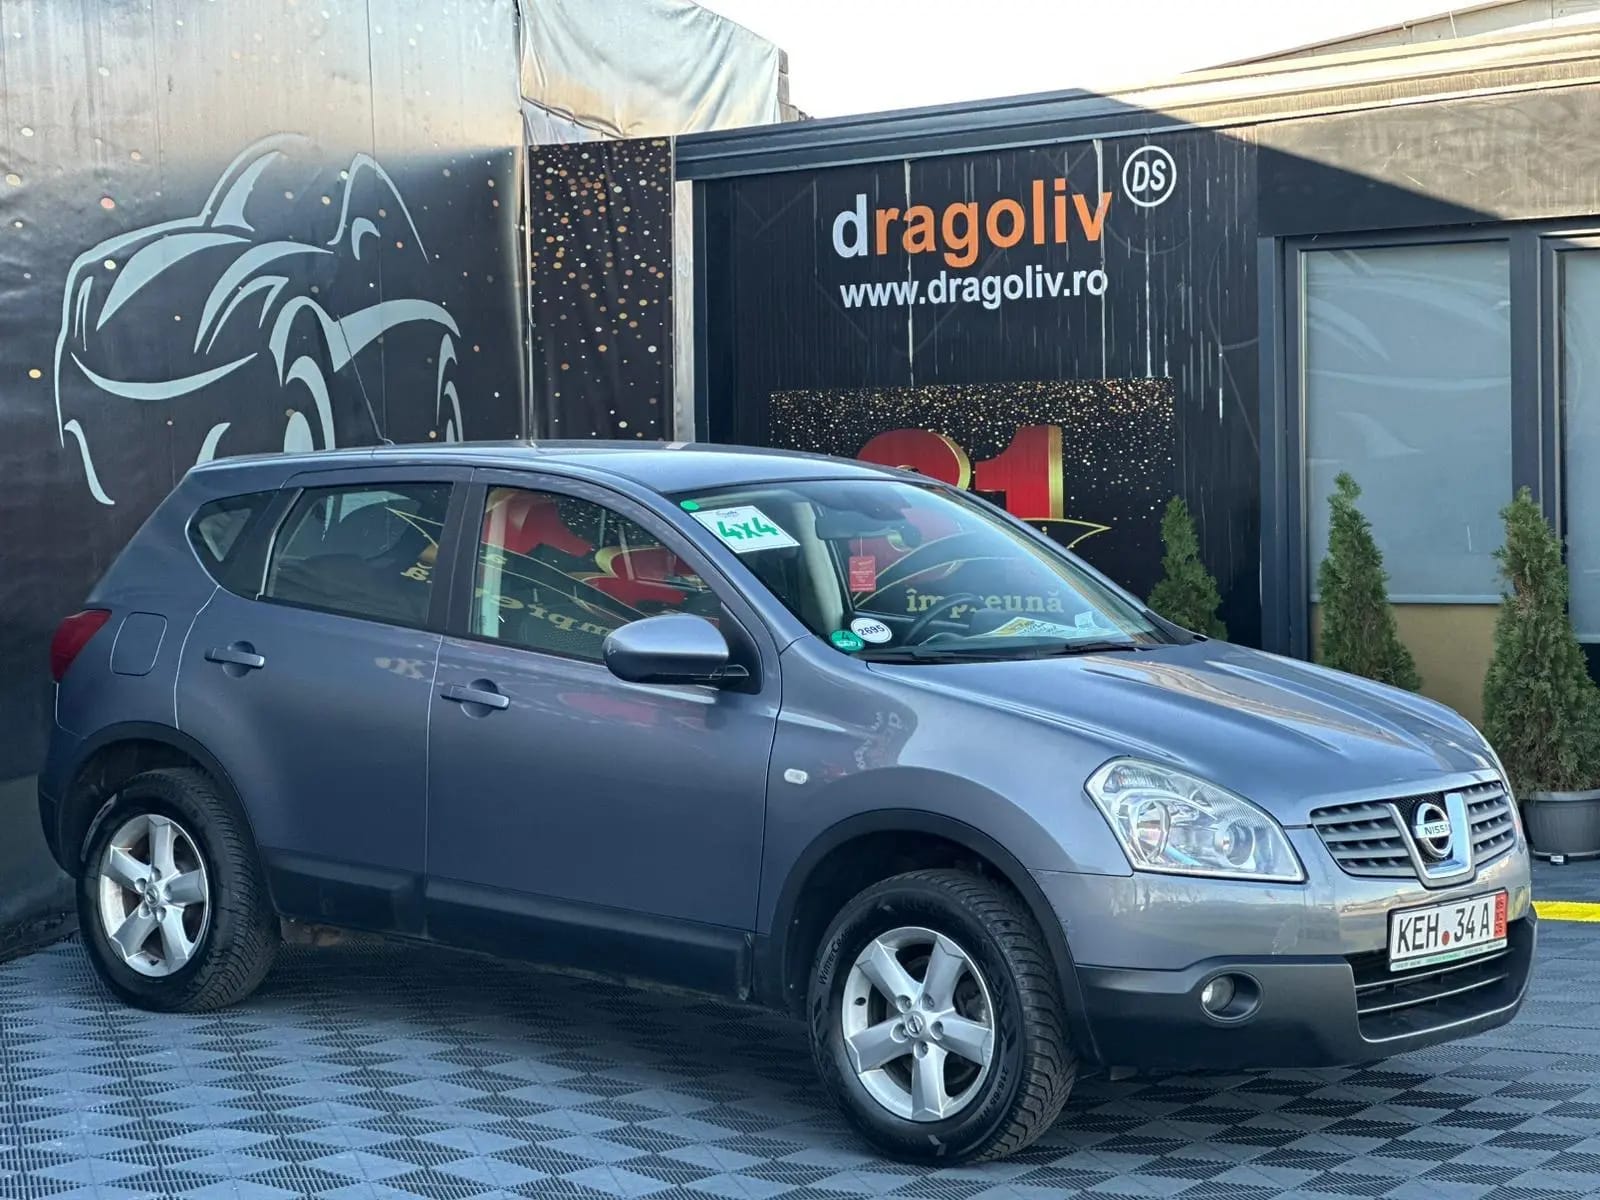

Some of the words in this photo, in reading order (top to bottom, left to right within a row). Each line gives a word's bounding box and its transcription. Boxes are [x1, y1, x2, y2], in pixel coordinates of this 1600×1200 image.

[1132, 158, 1166, 193] DS
[832, 178, 1112, 268] dragoliv
[839, 264, 1109, 310] www.dragoliv.ro
[1423, 823, 1451, 836] NISS
[1397, 912, 1440, 954] KEH
